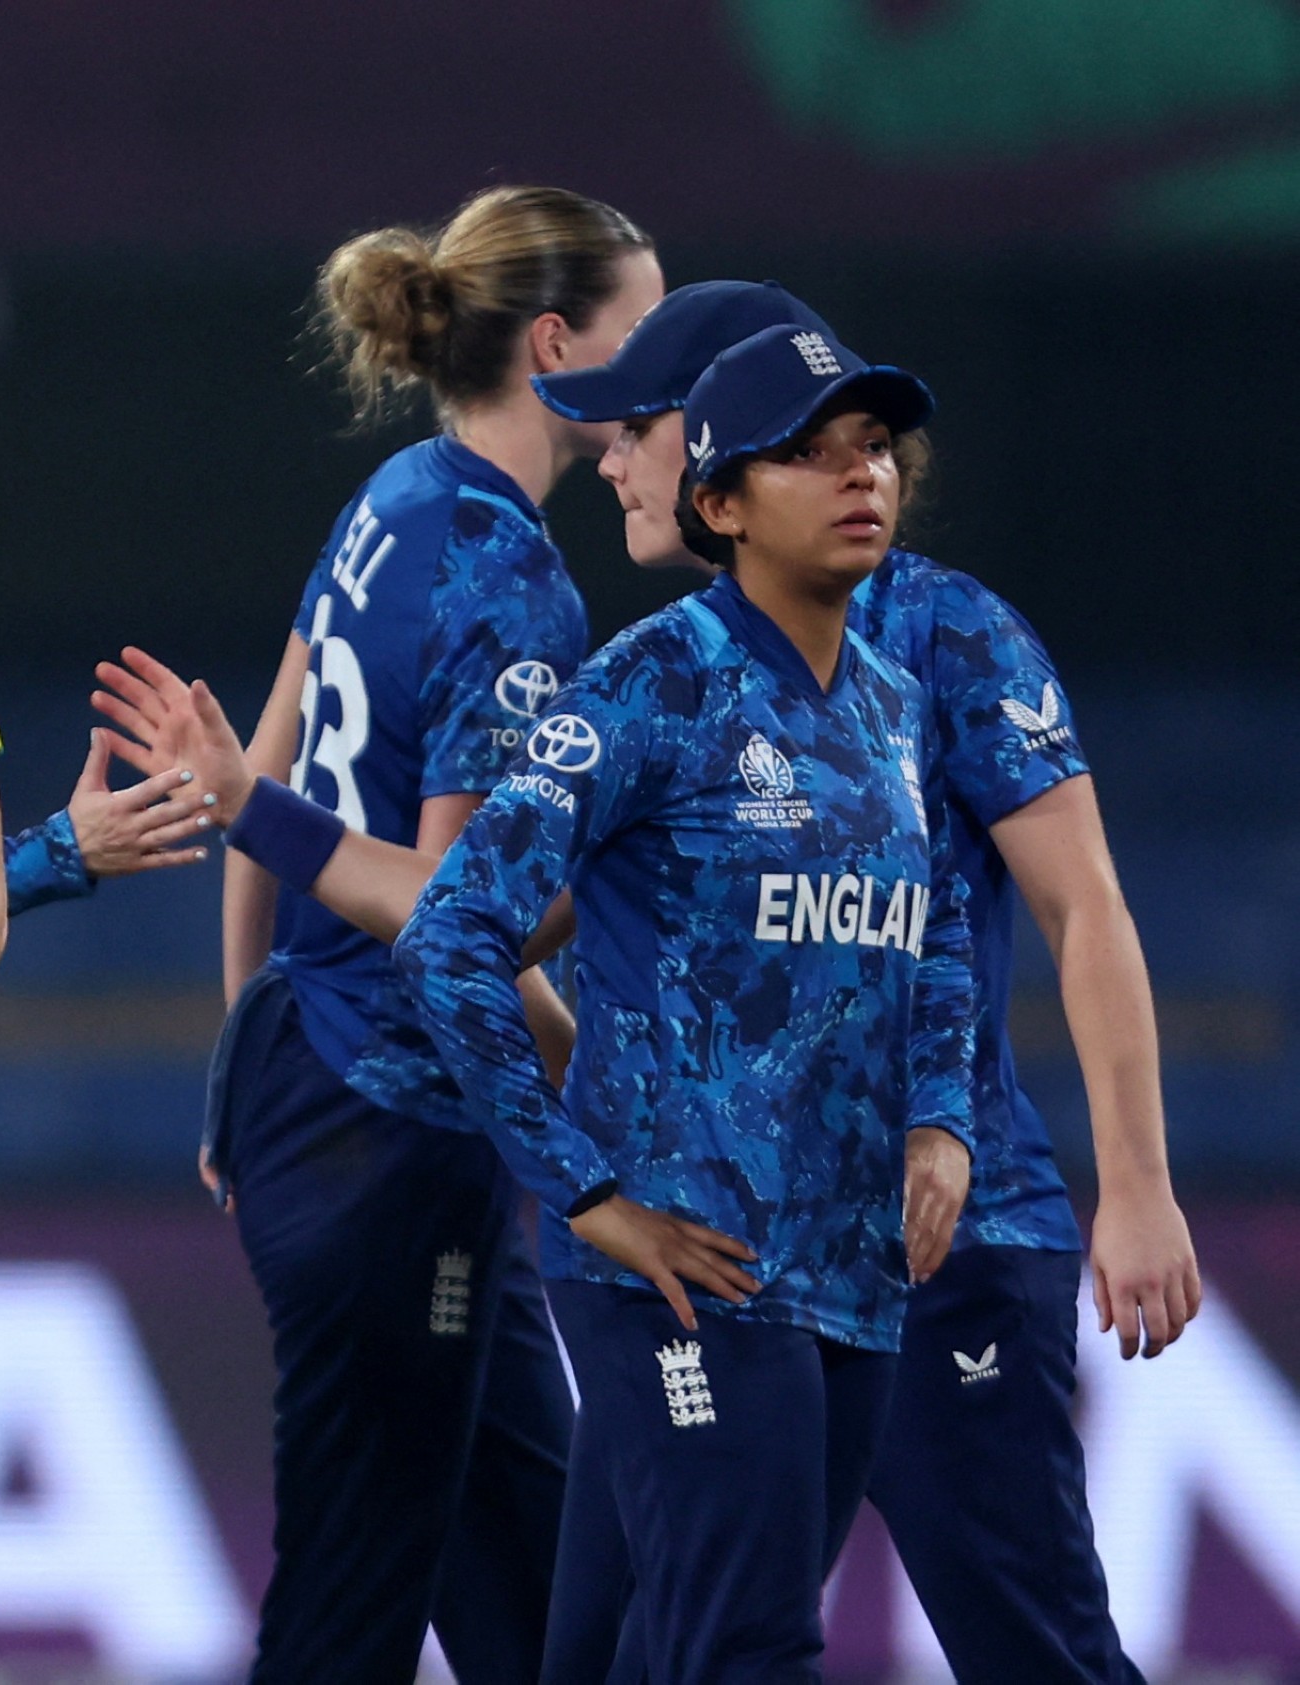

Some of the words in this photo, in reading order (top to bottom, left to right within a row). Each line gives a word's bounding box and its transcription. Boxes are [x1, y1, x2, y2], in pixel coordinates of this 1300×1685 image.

[508, 772, 575, 815] TOYOTA
[761, 788, 784, 799] ICC
[735, 808, 787, 821] WORLD
[789, 807, 814, 820] CUP
